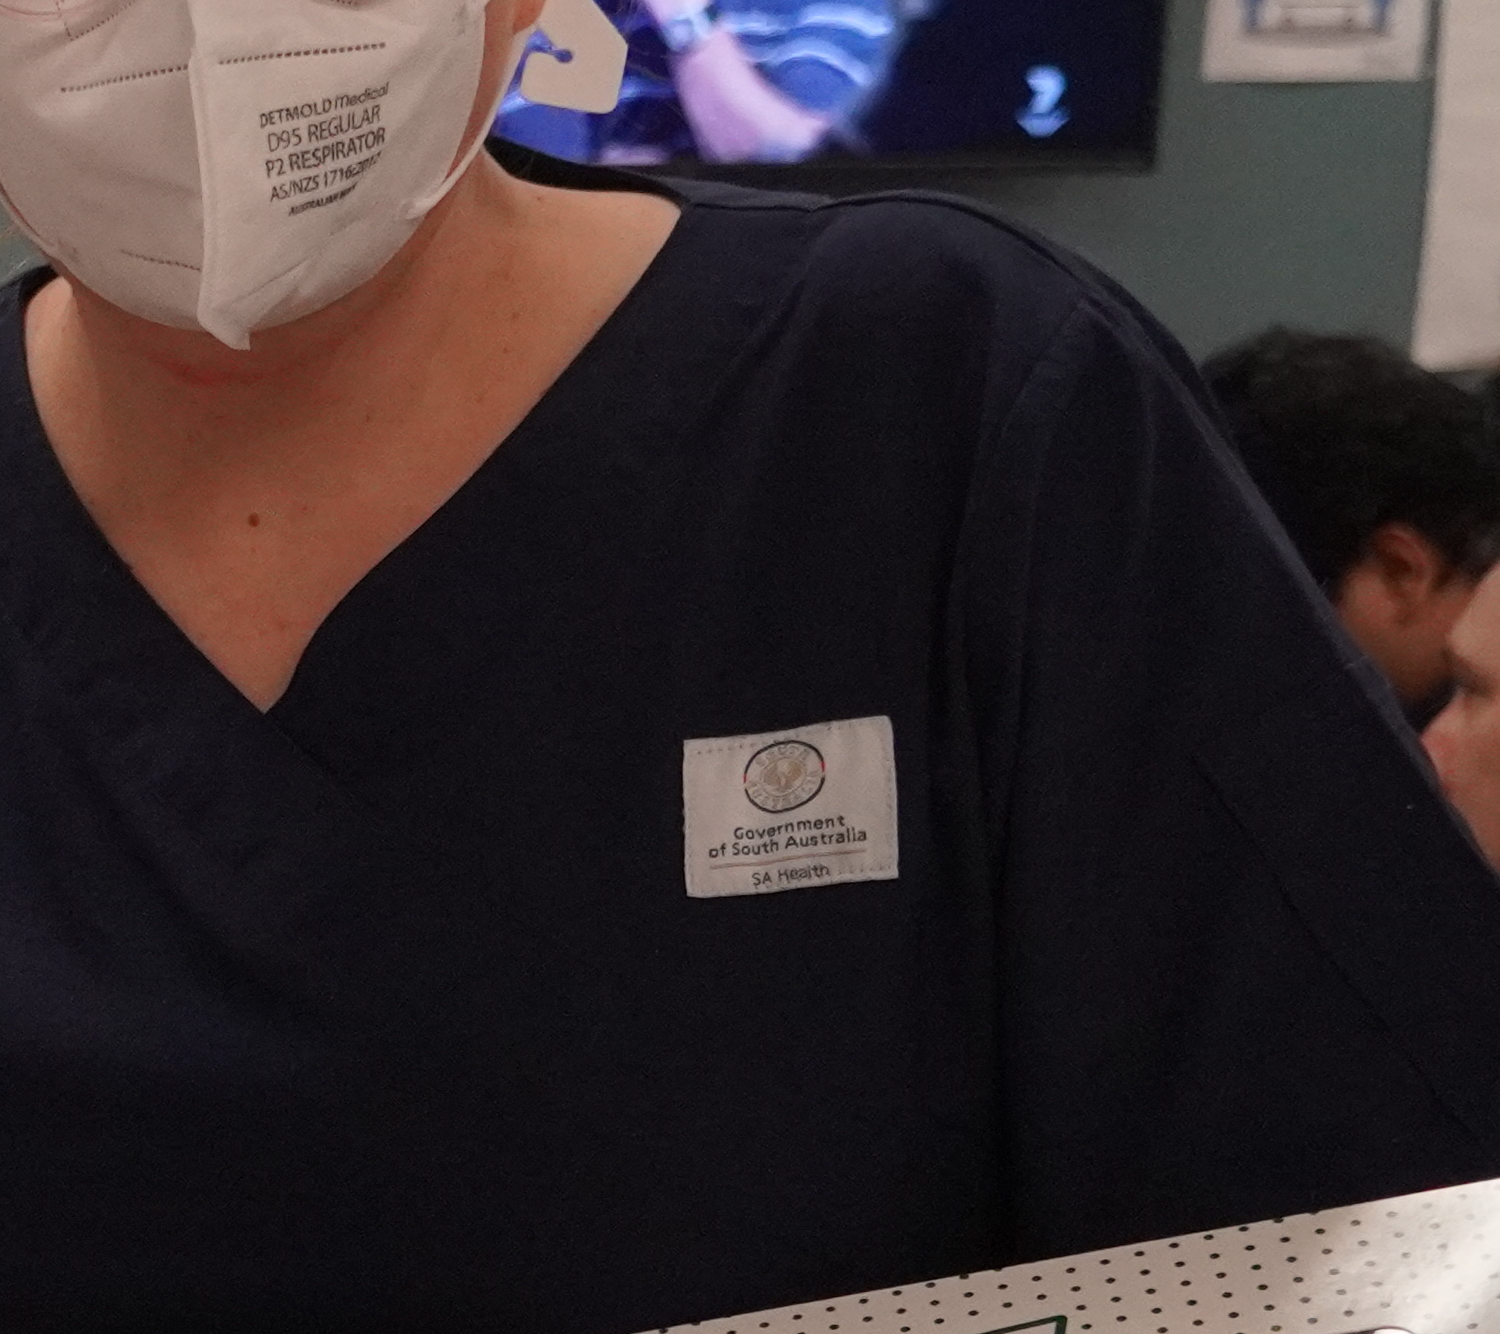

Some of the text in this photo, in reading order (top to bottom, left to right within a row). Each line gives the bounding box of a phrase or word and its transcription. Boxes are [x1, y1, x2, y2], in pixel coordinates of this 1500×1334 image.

[259, 98, 333, 129] DETMOLD
[267, 104, 382, 153] D95 REGULAR
[265, 127, 386, 179] P2 RESPIRATOR
[270, 175, 321, 203] AS/NZS
[708, 826, 867, 859] of South Australia
[733, 815, 846, 841] Government
[751, 863, 830, 887] SA Health
